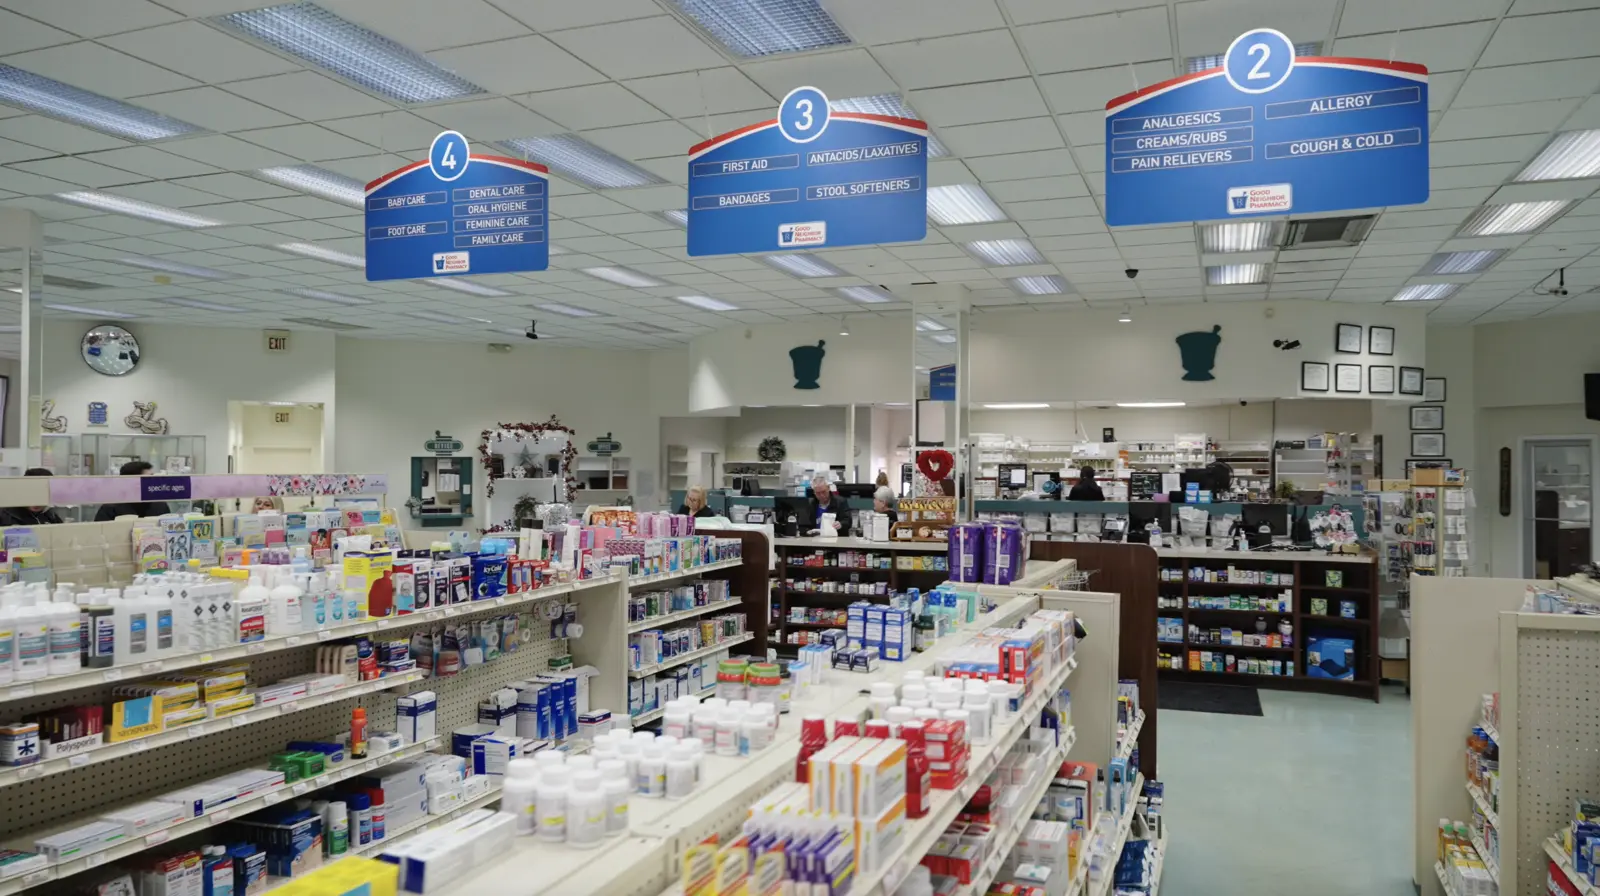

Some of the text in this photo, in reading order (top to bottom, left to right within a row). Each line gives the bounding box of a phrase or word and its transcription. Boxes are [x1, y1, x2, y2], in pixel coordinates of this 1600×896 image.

[1247, 43, 1271, 80] 2
[1310, 94, 1373, 113] ALLERGY
[794, 99, 813, 130] 3
[1142, 111, 1222, 130] ANALGESICS
[1136, 131, 1228, 150] CREAMS/RUBS
[1290, 133, 1394, 155] COUGH & COLD
[441, 142, 457, 170] 4
[810, 143, 918, 164] ANTACIDS/LAXATIVES
[1131, 150, 1232, 170] PAIN RELIEVERS
[722, 159, 768, 172] FIRST AID
[470, 186, 525, 198] DENTAL CARE
[816, 179, 911, 198] STOOL SOFTENERS
[388, 194, 426, 208] BABY CARE
[719, 192, 771, 206] BANDAGES
[468, 202, 528, 214] ORAL HYGIENE
[388, 224, 426, 236] FOOT CARE
[466, 216, 530, 230] FEMININE CARE
[472, 232, 524, 245] FAMILY CARE
[268, 337, 286, 350] EXIT
[275, 412, 290, 422] EXIT
[148, 484, 170, 492] specific
[56, 736, 96, 752] Polysporin
